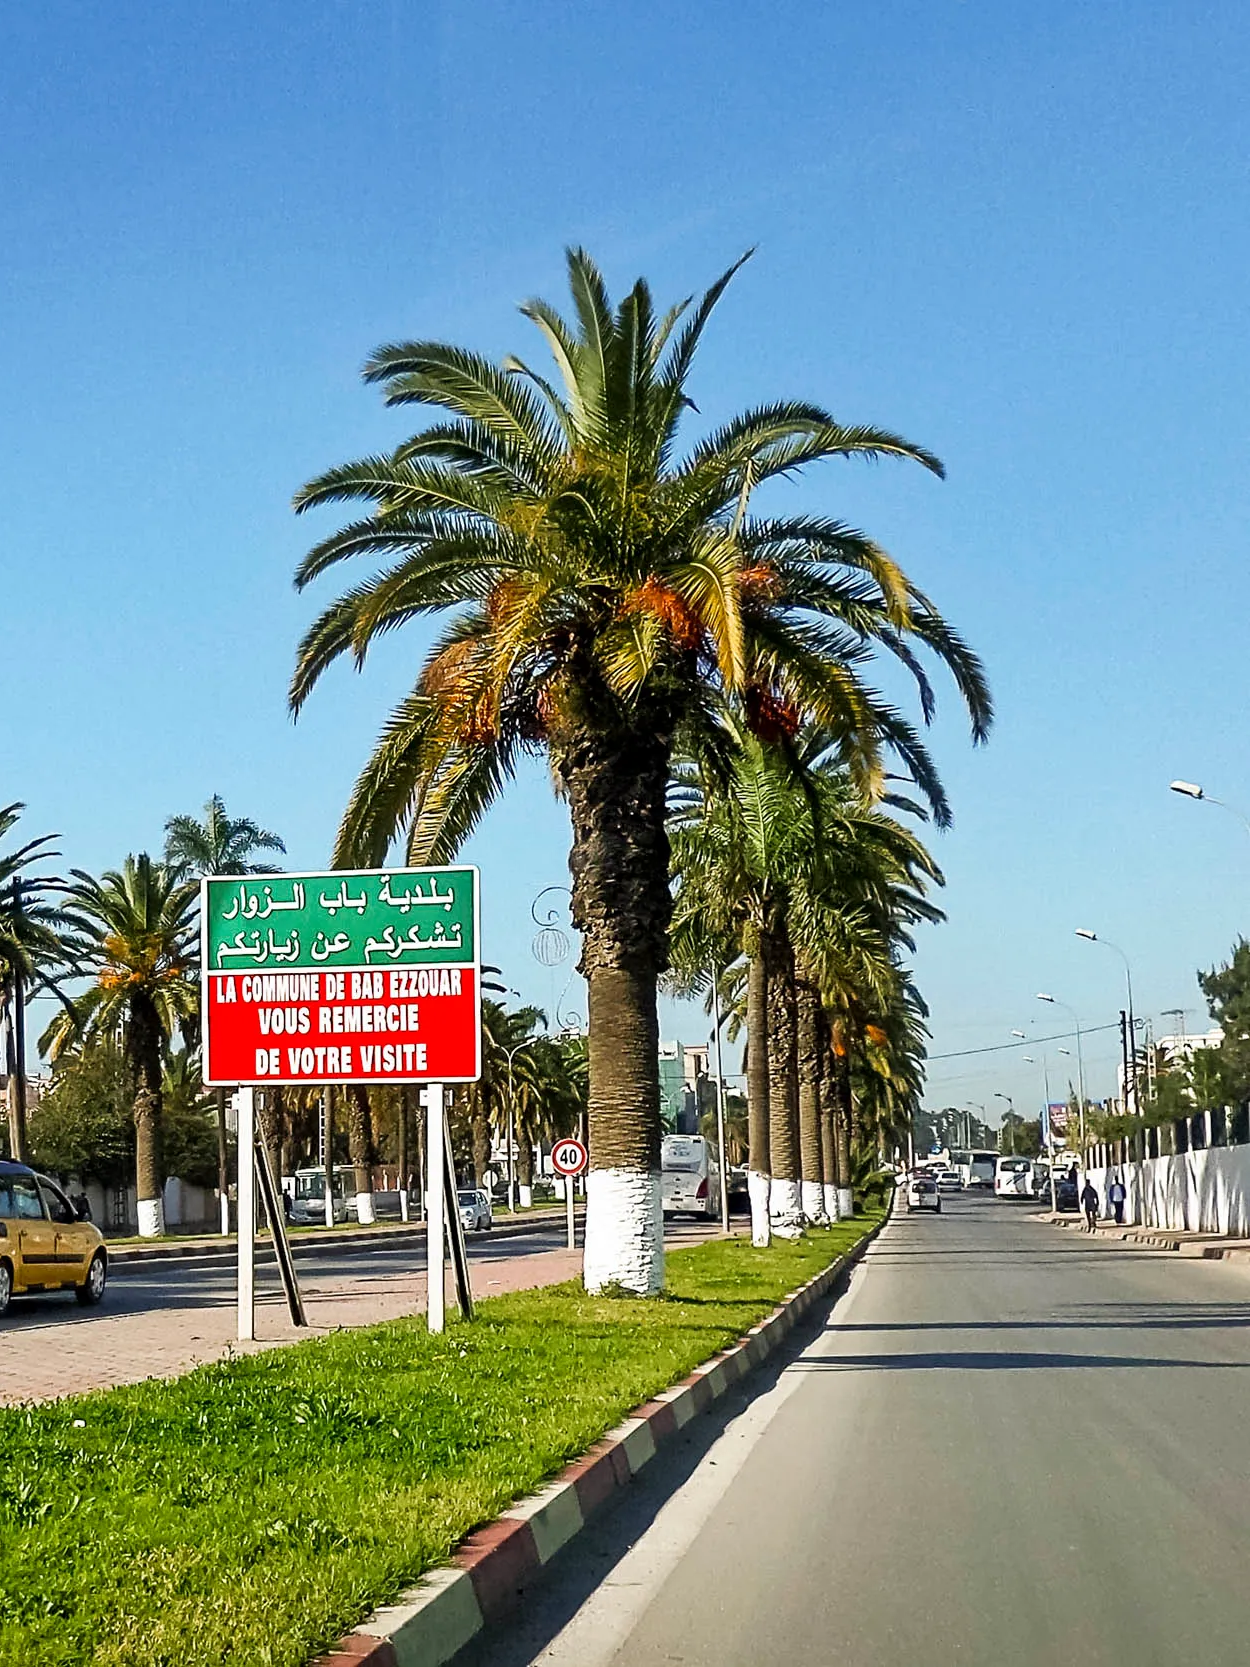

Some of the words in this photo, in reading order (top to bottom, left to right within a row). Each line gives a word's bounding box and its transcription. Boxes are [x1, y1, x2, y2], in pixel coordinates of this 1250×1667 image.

[221, 882, 305, 920] الزوار
[319, 880, 367, 916] باب
[378, 874, 454, 913] بلدية
[216, 928, 300, 969] زيارتكم
[311, 932, 350, 961] عن
[364, 921, 462, 965] تشكركم
[217, 976, 237, 1003] LA
[242, 974, 319, 1003] COMMUNE
[326, 973, 345, 1001] DE
[351, 972, 384, 1000] BAB
[390, 969, 462, 998] EZZOUAR
[258, 1008, 311, 1035] VOUS
[319, 1004, 419, 1033] REMERCIE
[255, 1048, 280, 1076] DE
[288, 1046, 352, 1075] VOTRE
[360, 1043, 428, 1073] VISITE
[560, 1148, 577, 1165] 40
